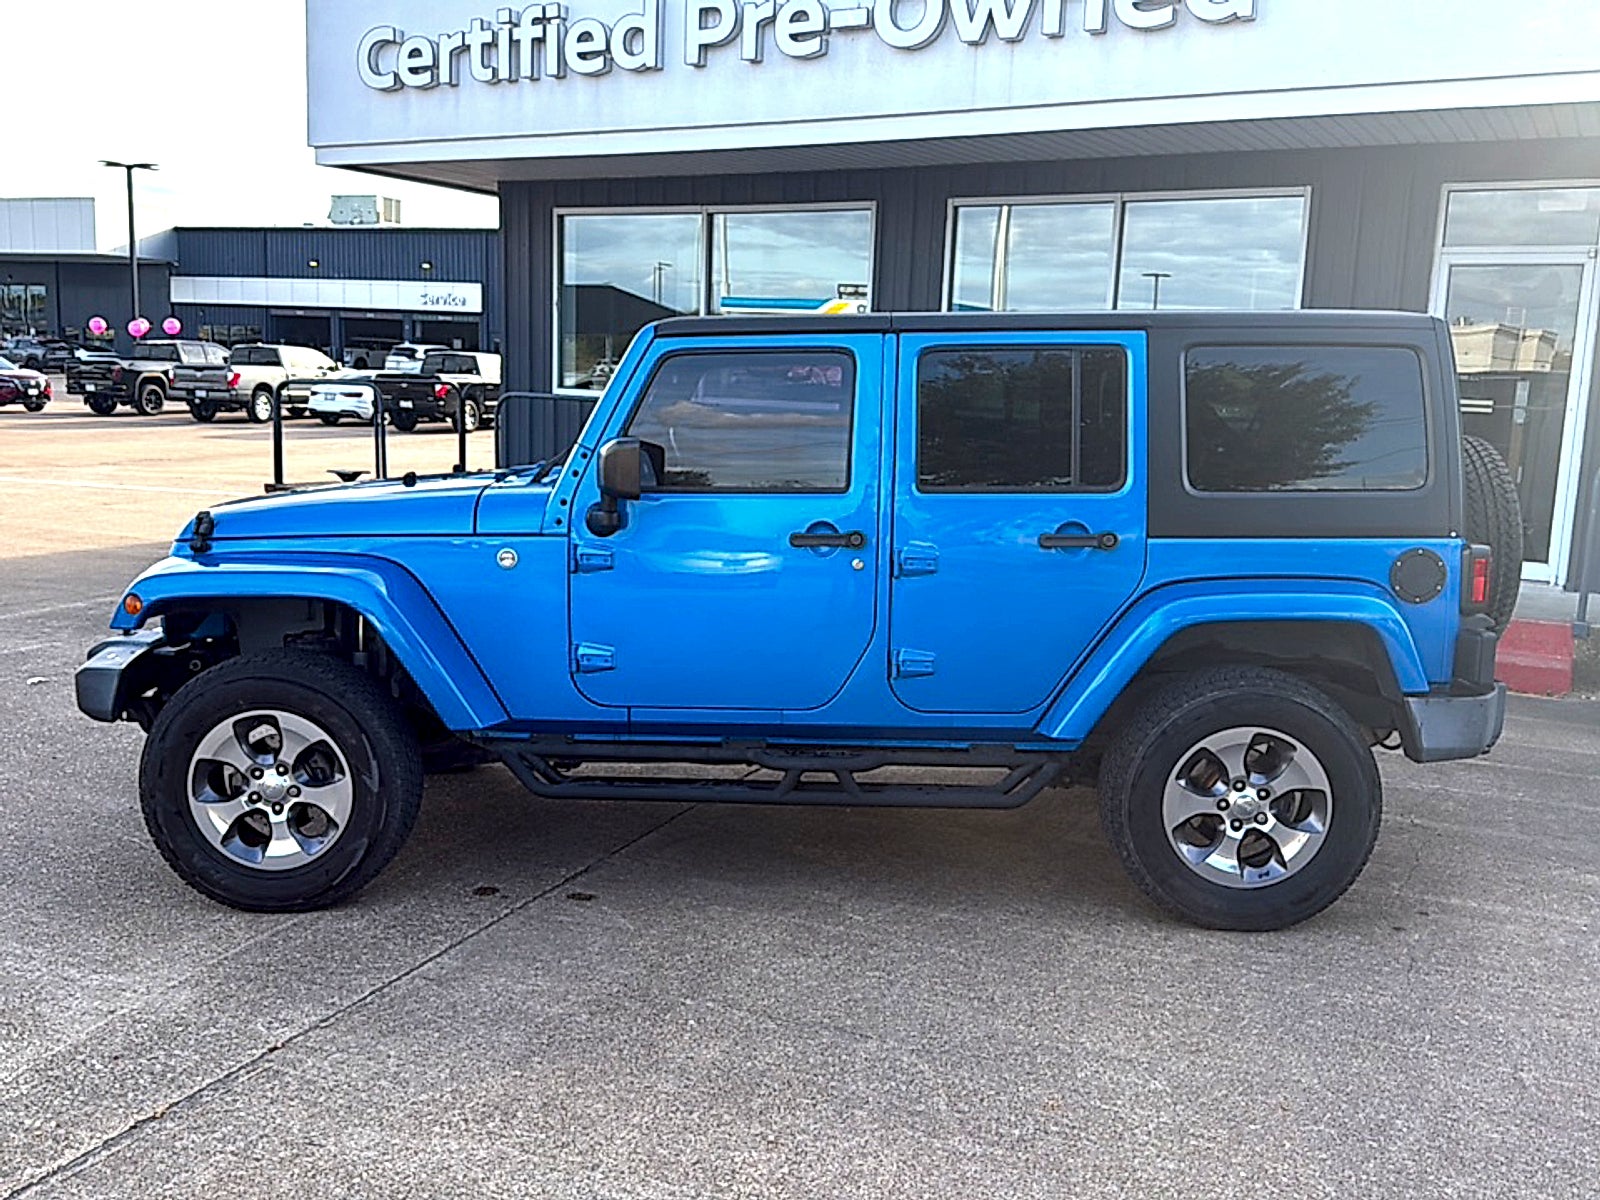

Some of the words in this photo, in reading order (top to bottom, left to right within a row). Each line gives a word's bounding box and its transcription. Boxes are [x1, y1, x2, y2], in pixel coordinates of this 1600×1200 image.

[357, 0, 665, 92] Certified
[684, 0, 1257, 68] Pre-Ow
[420, 293, 467, 306] Service
